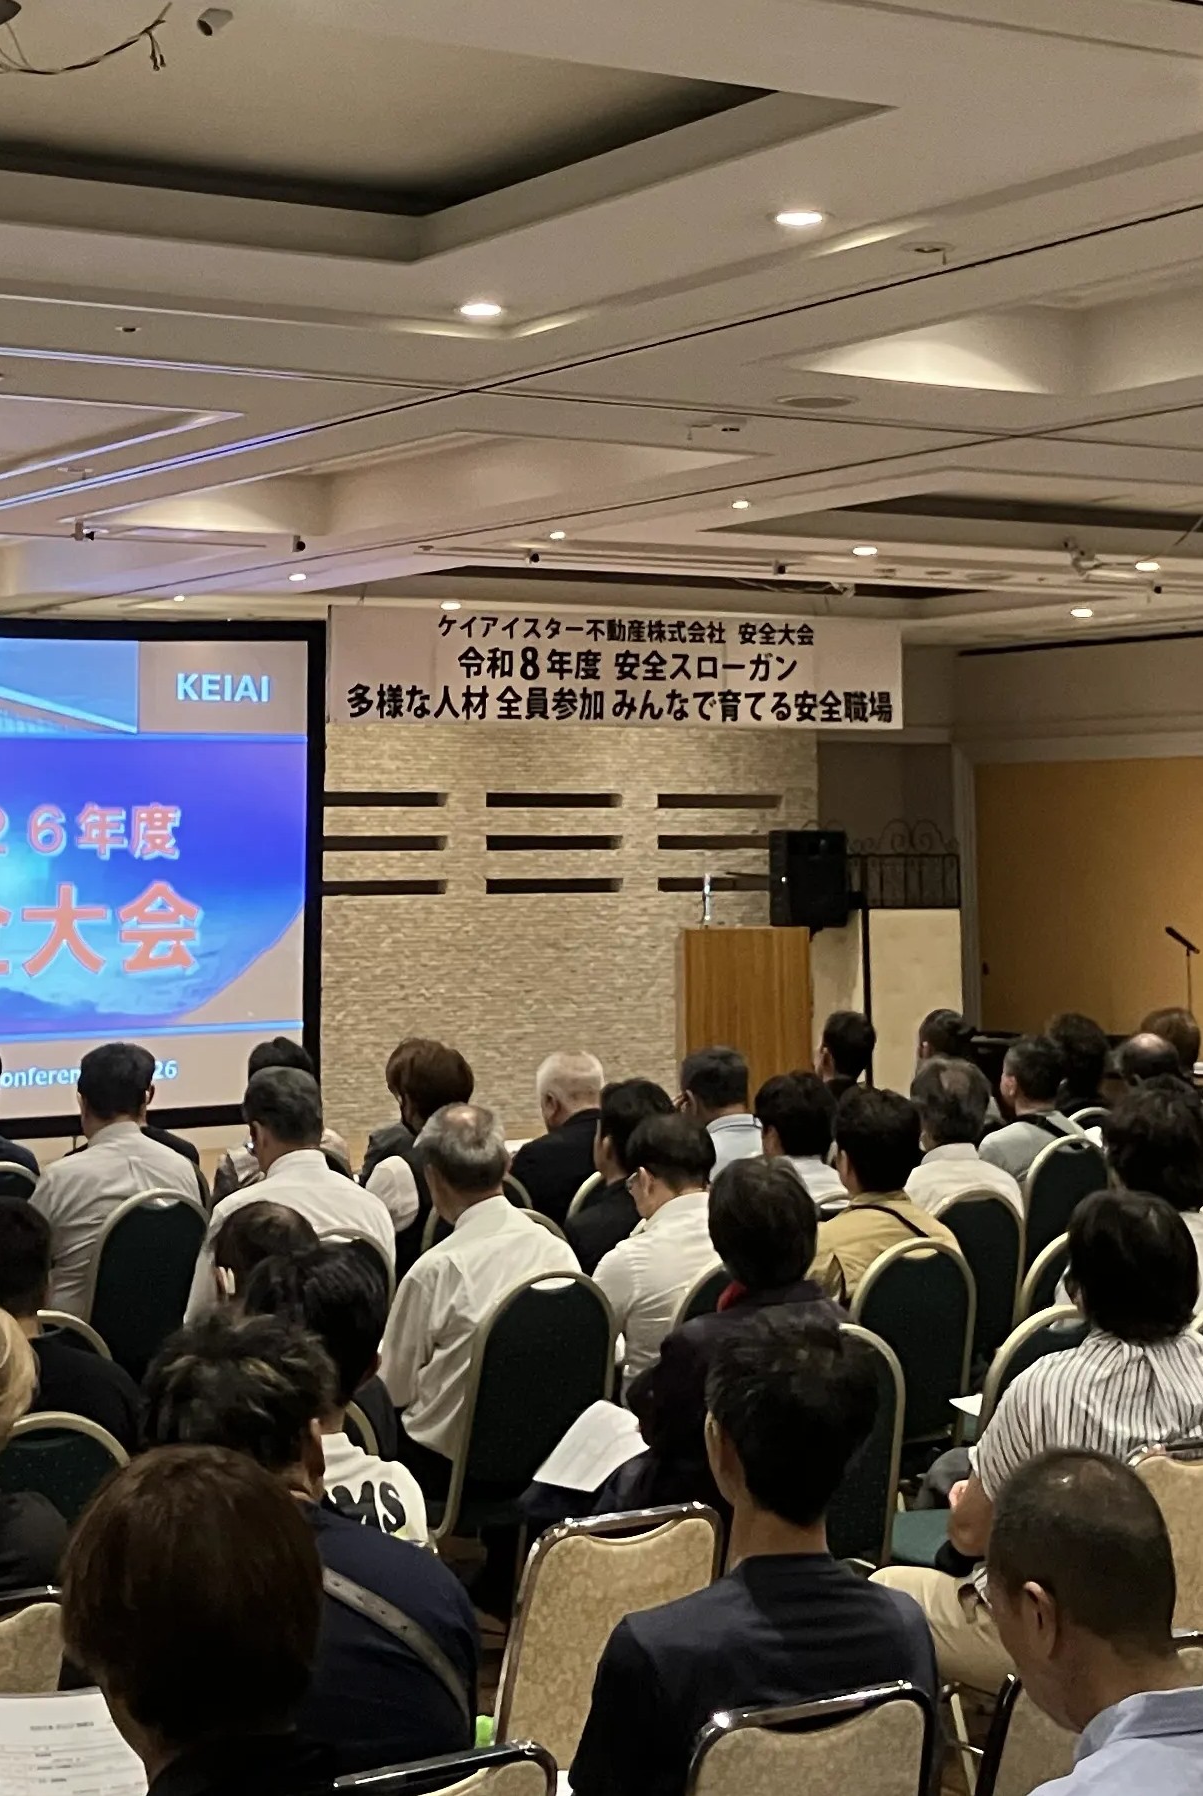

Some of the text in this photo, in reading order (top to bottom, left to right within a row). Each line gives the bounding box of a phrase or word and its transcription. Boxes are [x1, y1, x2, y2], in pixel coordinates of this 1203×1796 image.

[438, 615, 815, 646] ケイアイスター不動産株式会社 安全大会
[458, 646, 798, 681] 令和8年度 安全スローガン
[176, 672, 271, 703] KEIAI
[347, 683, 892, 724] 多様な人材 全員参加 みんなで育てる安全職場
[0, 1065, 80, 1088] onferen
[154, 1060, 177, 1080] 26
